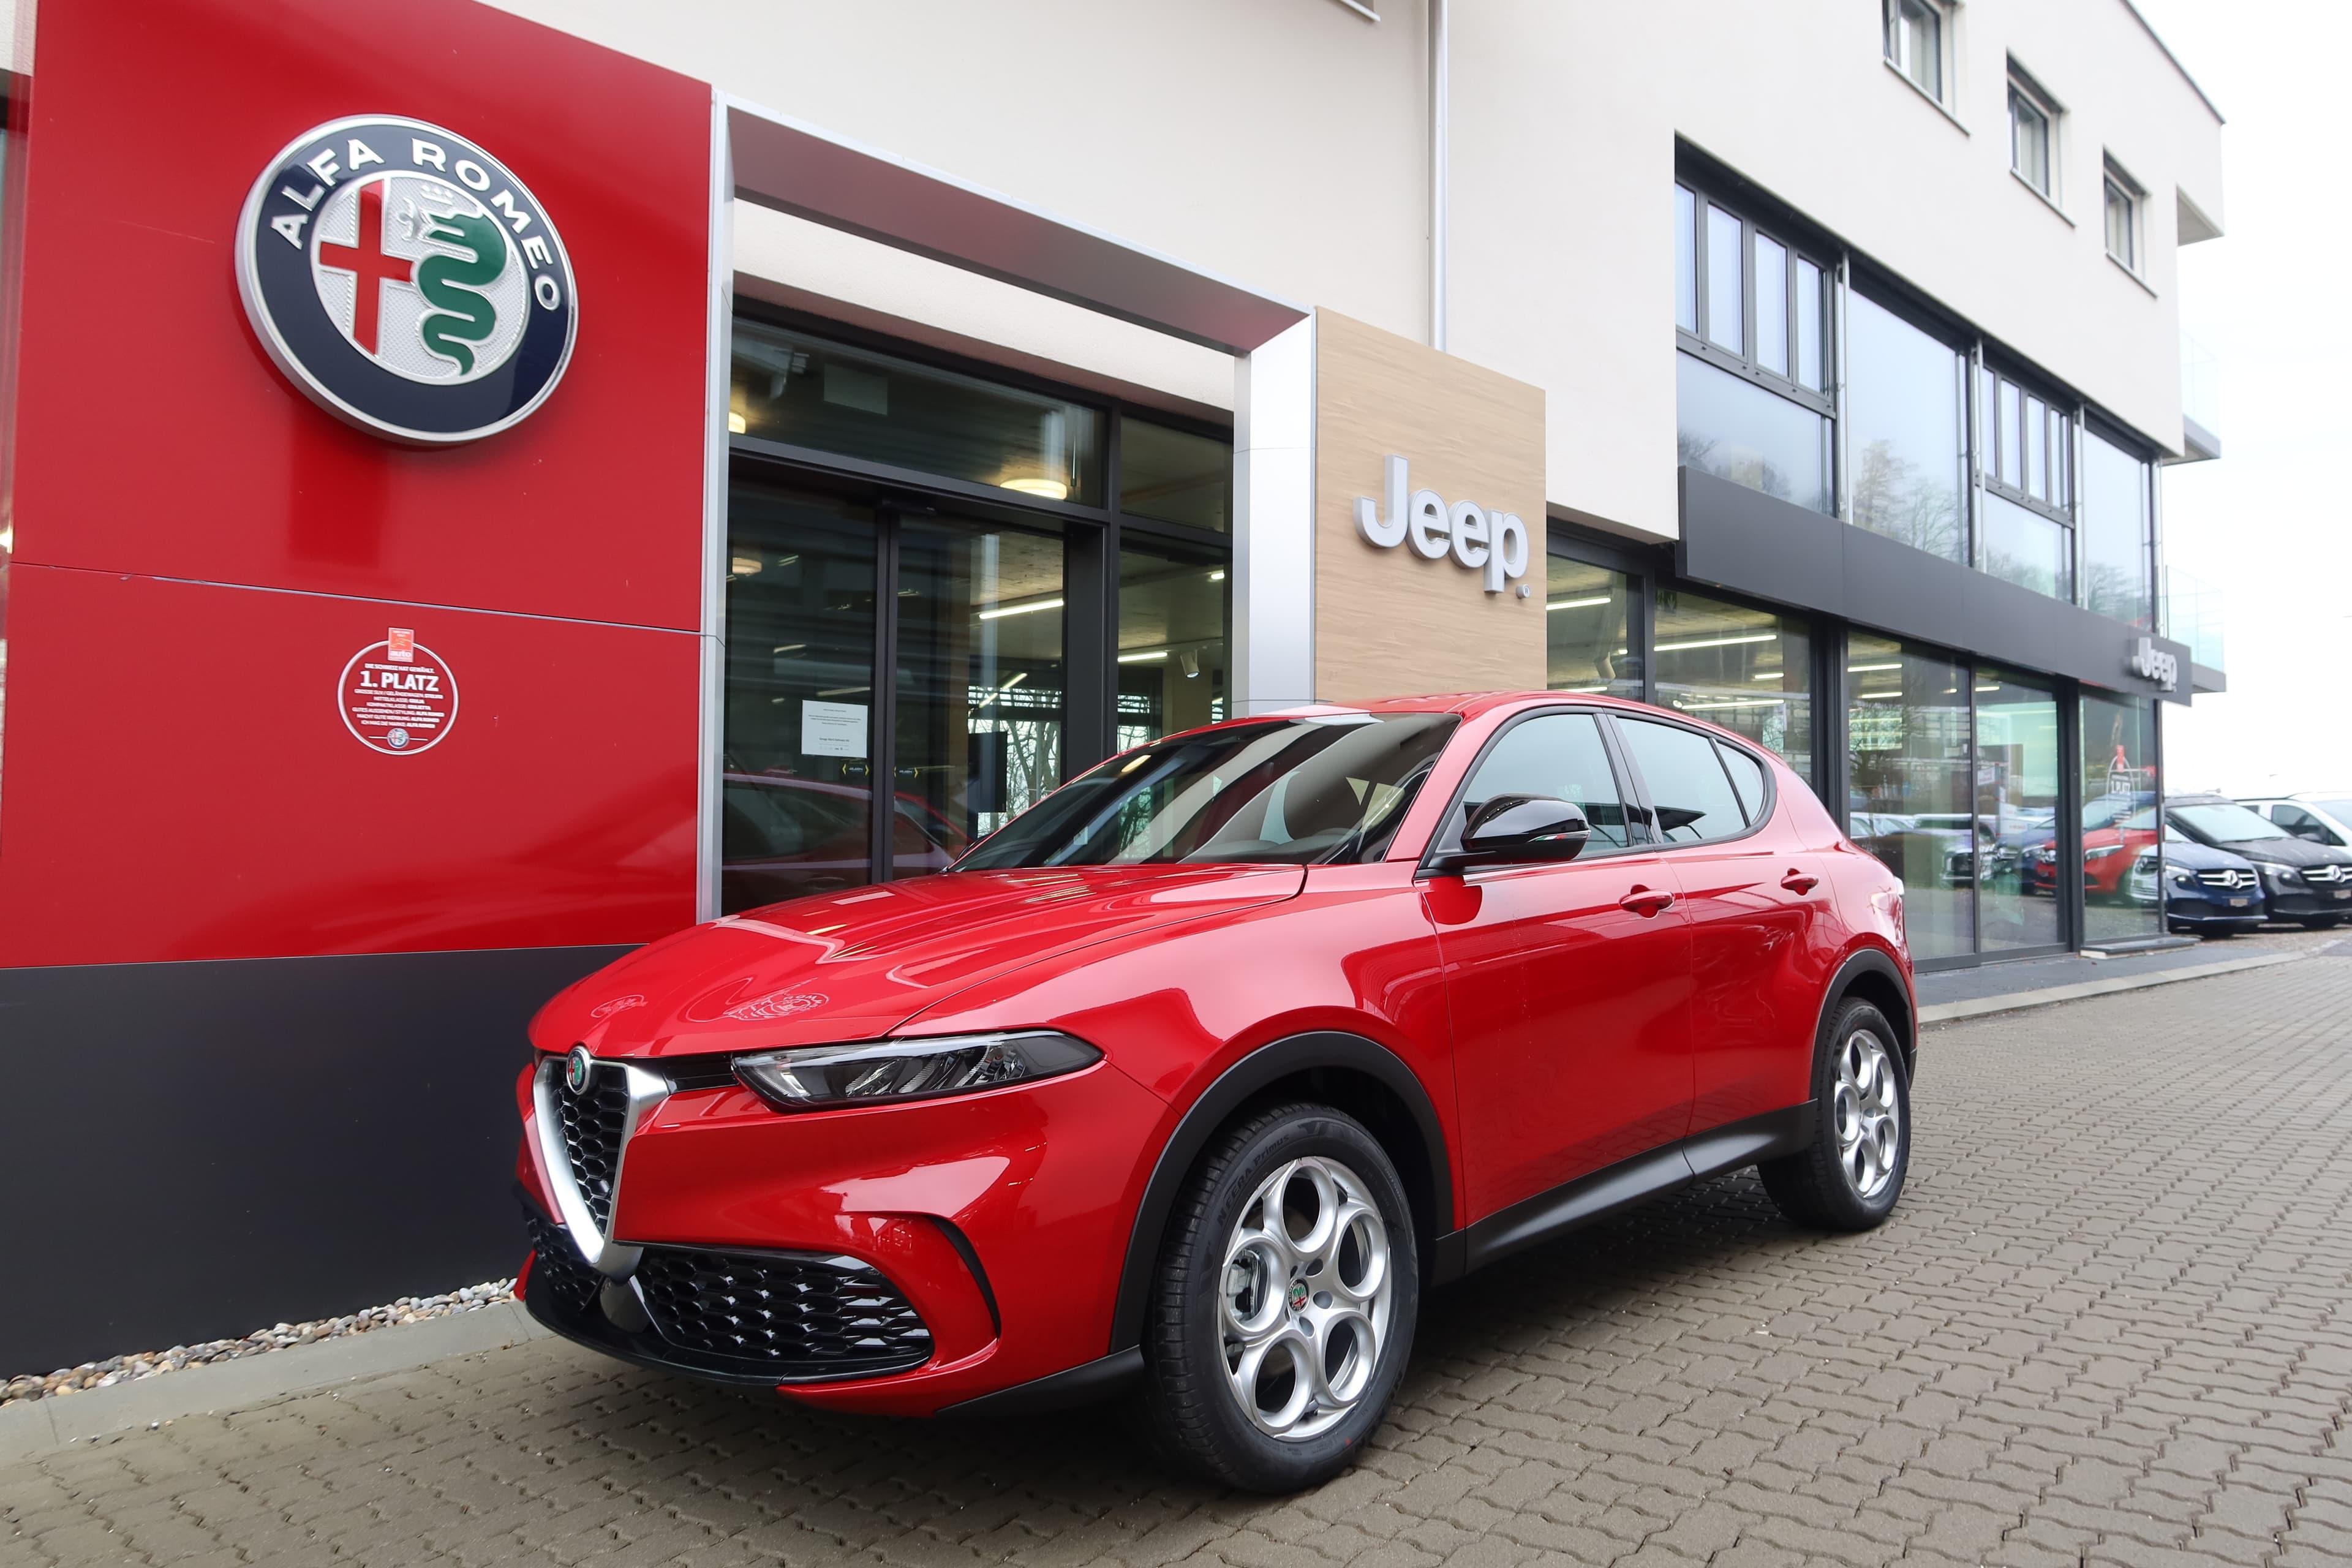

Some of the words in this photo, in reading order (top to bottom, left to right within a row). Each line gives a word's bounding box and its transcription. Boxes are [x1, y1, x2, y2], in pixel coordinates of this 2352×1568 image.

[271, 138, 385, 251] ALFA
[412, 138, 560, 311] ROMEO
[1352, 454, 1529, 594] Jeep
[360, 671, 378, 687] 1.
[381, 672, 439, 692] PLATZ
[2132, 637, 2177, 691] Jeep
[1253, 1134, 1289, 1165] Primus
